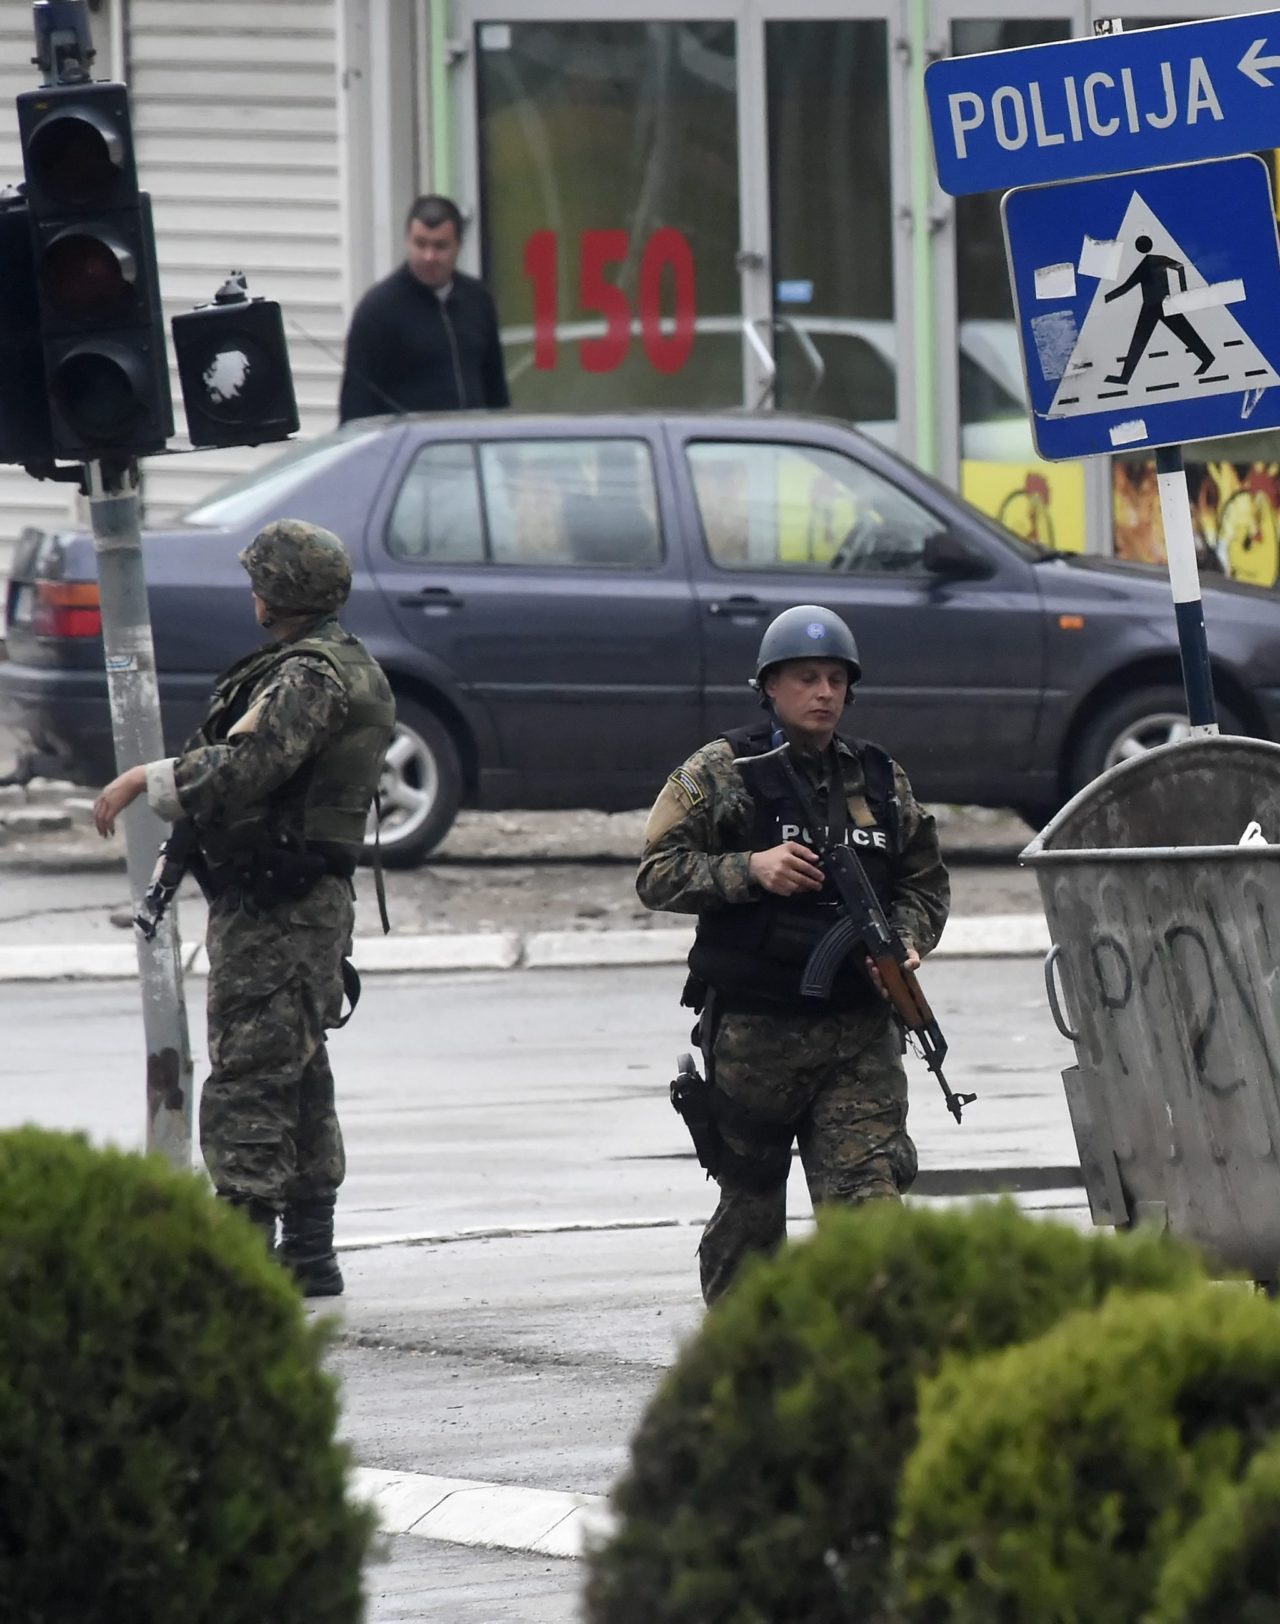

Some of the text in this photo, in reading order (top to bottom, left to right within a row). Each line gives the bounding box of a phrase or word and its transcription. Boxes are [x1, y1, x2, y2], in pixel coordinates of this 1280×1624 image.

[947, 56, 1225, 160] POLICIJA
[523, 226, 697, 375] 150
[782, 824, 887, 849] POICE
